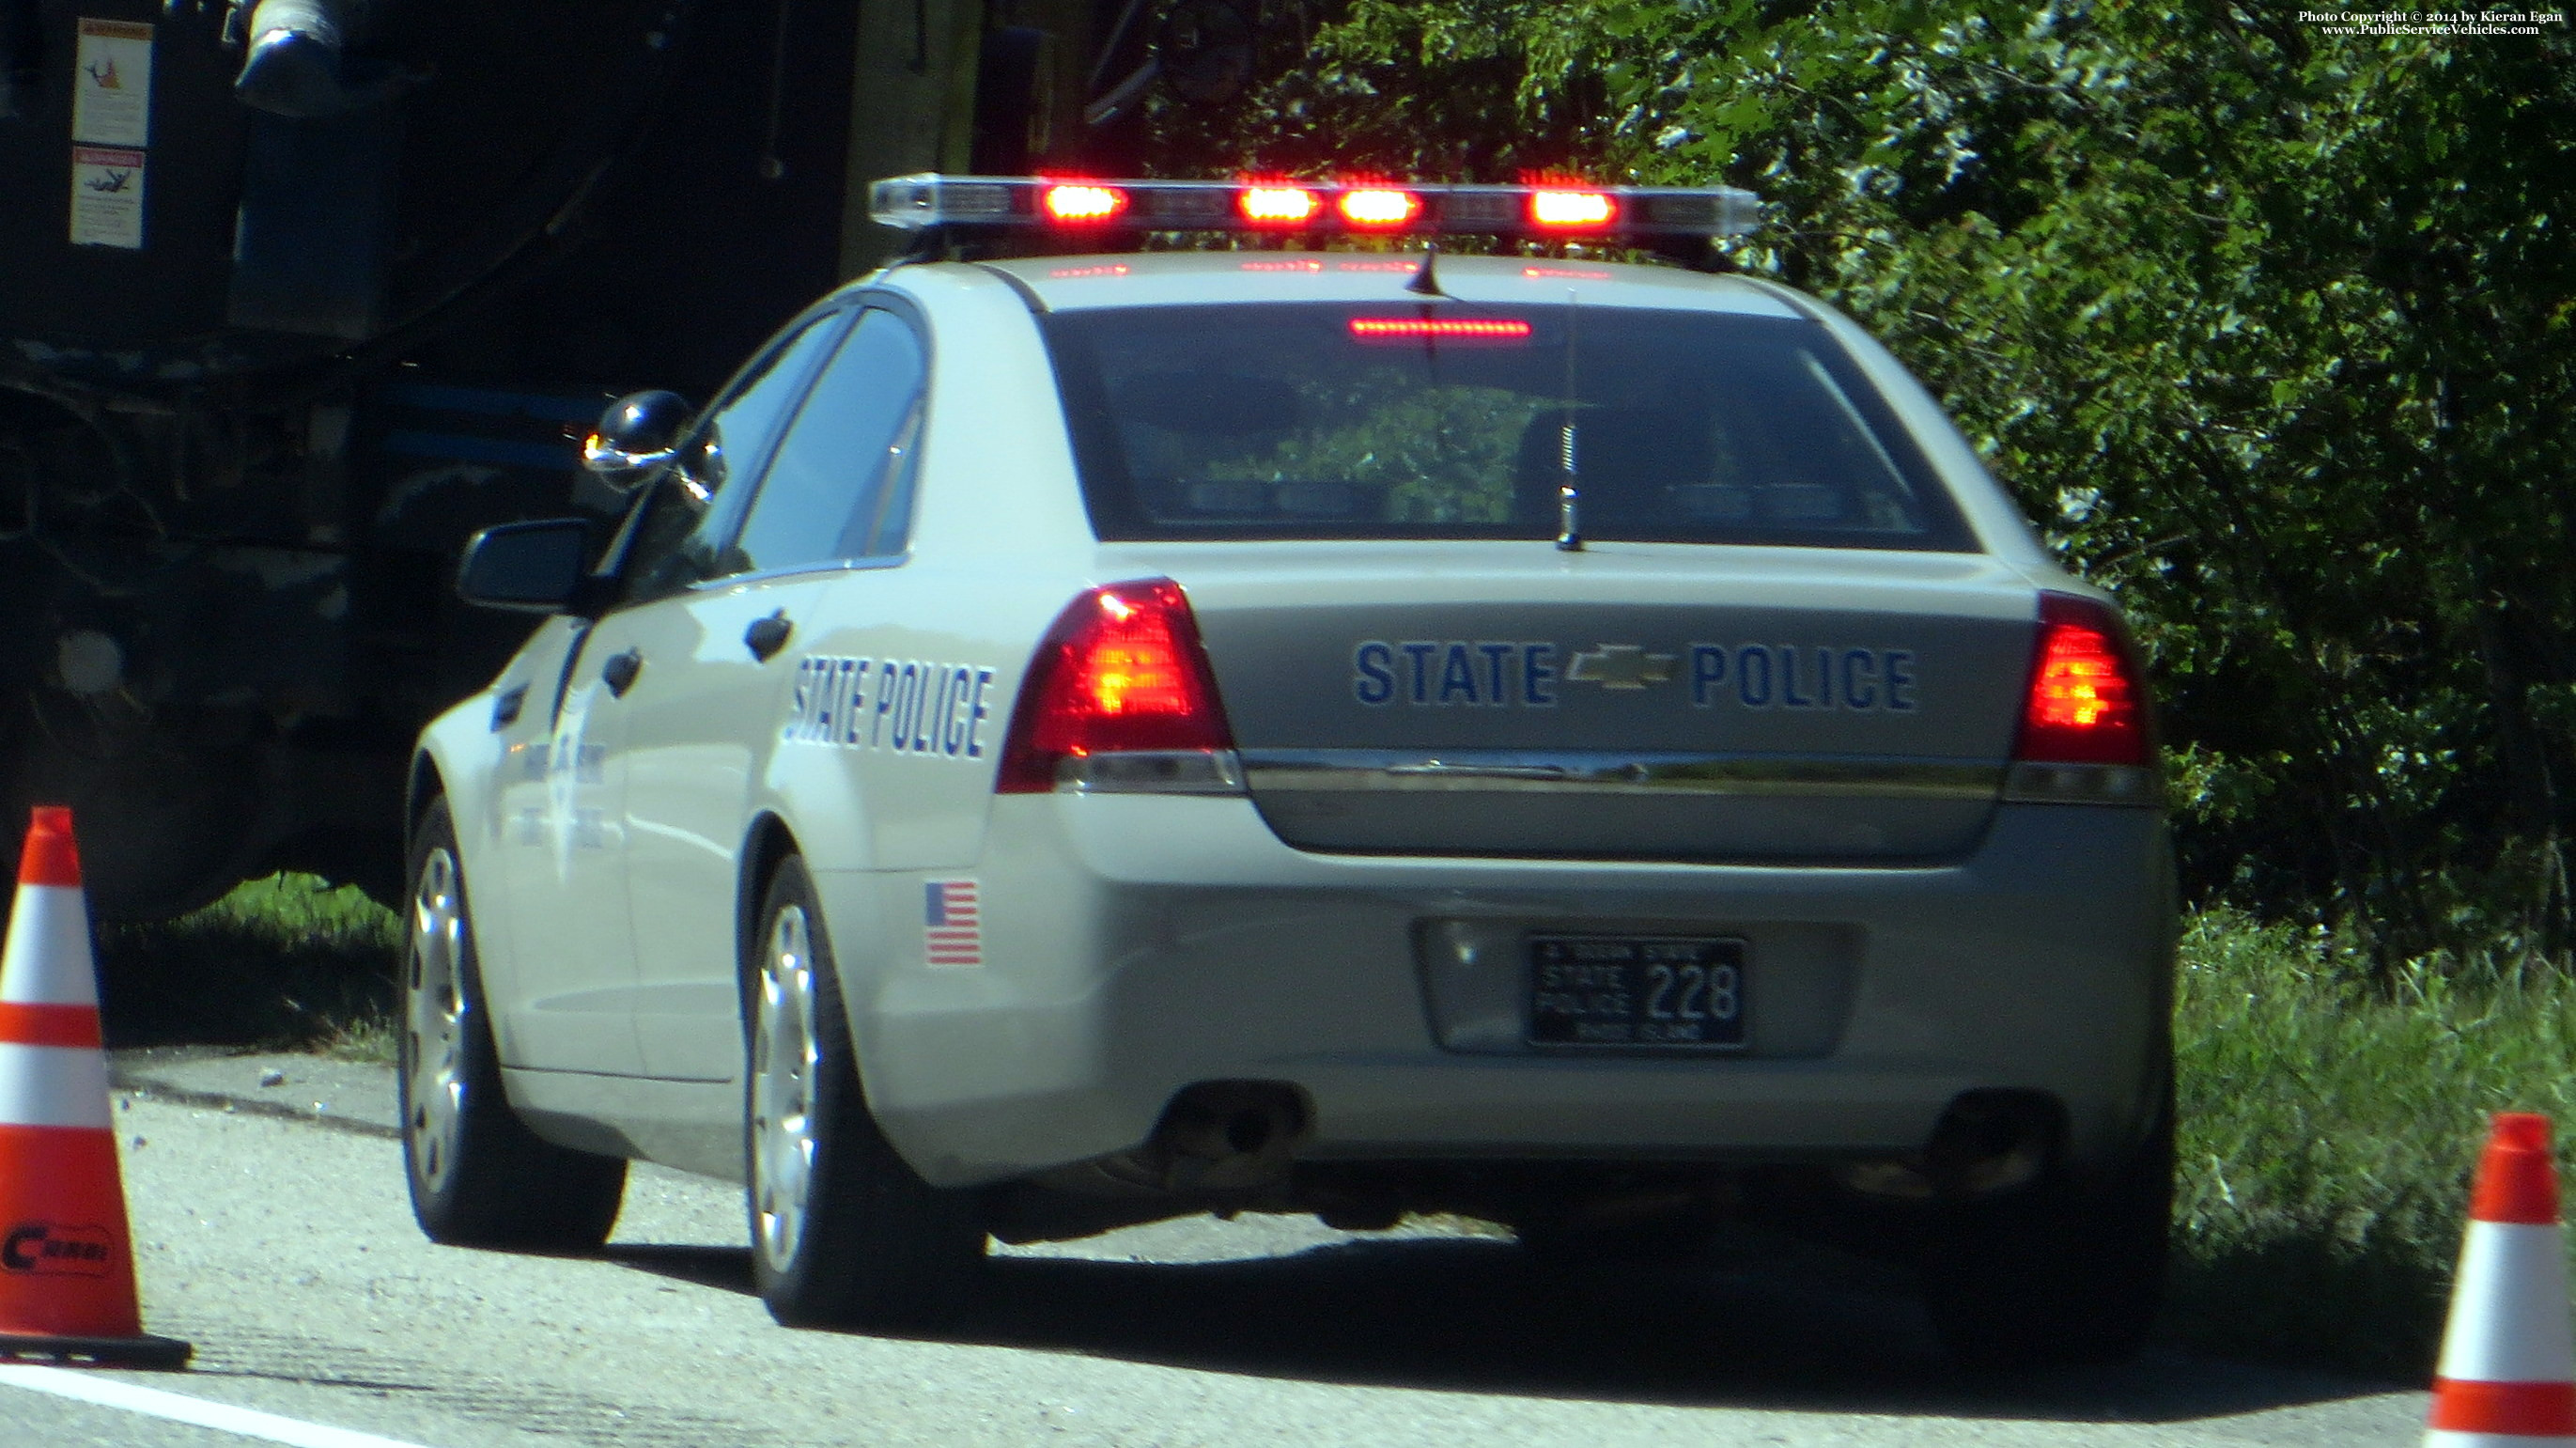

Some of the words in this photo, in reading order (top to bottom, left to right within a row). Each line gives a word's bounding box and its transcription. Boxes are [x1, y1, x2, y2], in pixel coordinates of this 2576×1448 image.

[783, 655, 873, 751] STATE
[870, 658, 996, 761] POLICE
[1353, 640, 1560, 709] STATE
[1690, 644, 1919, 713] POLICE
[1646, 963, 1738, 1020] 228
